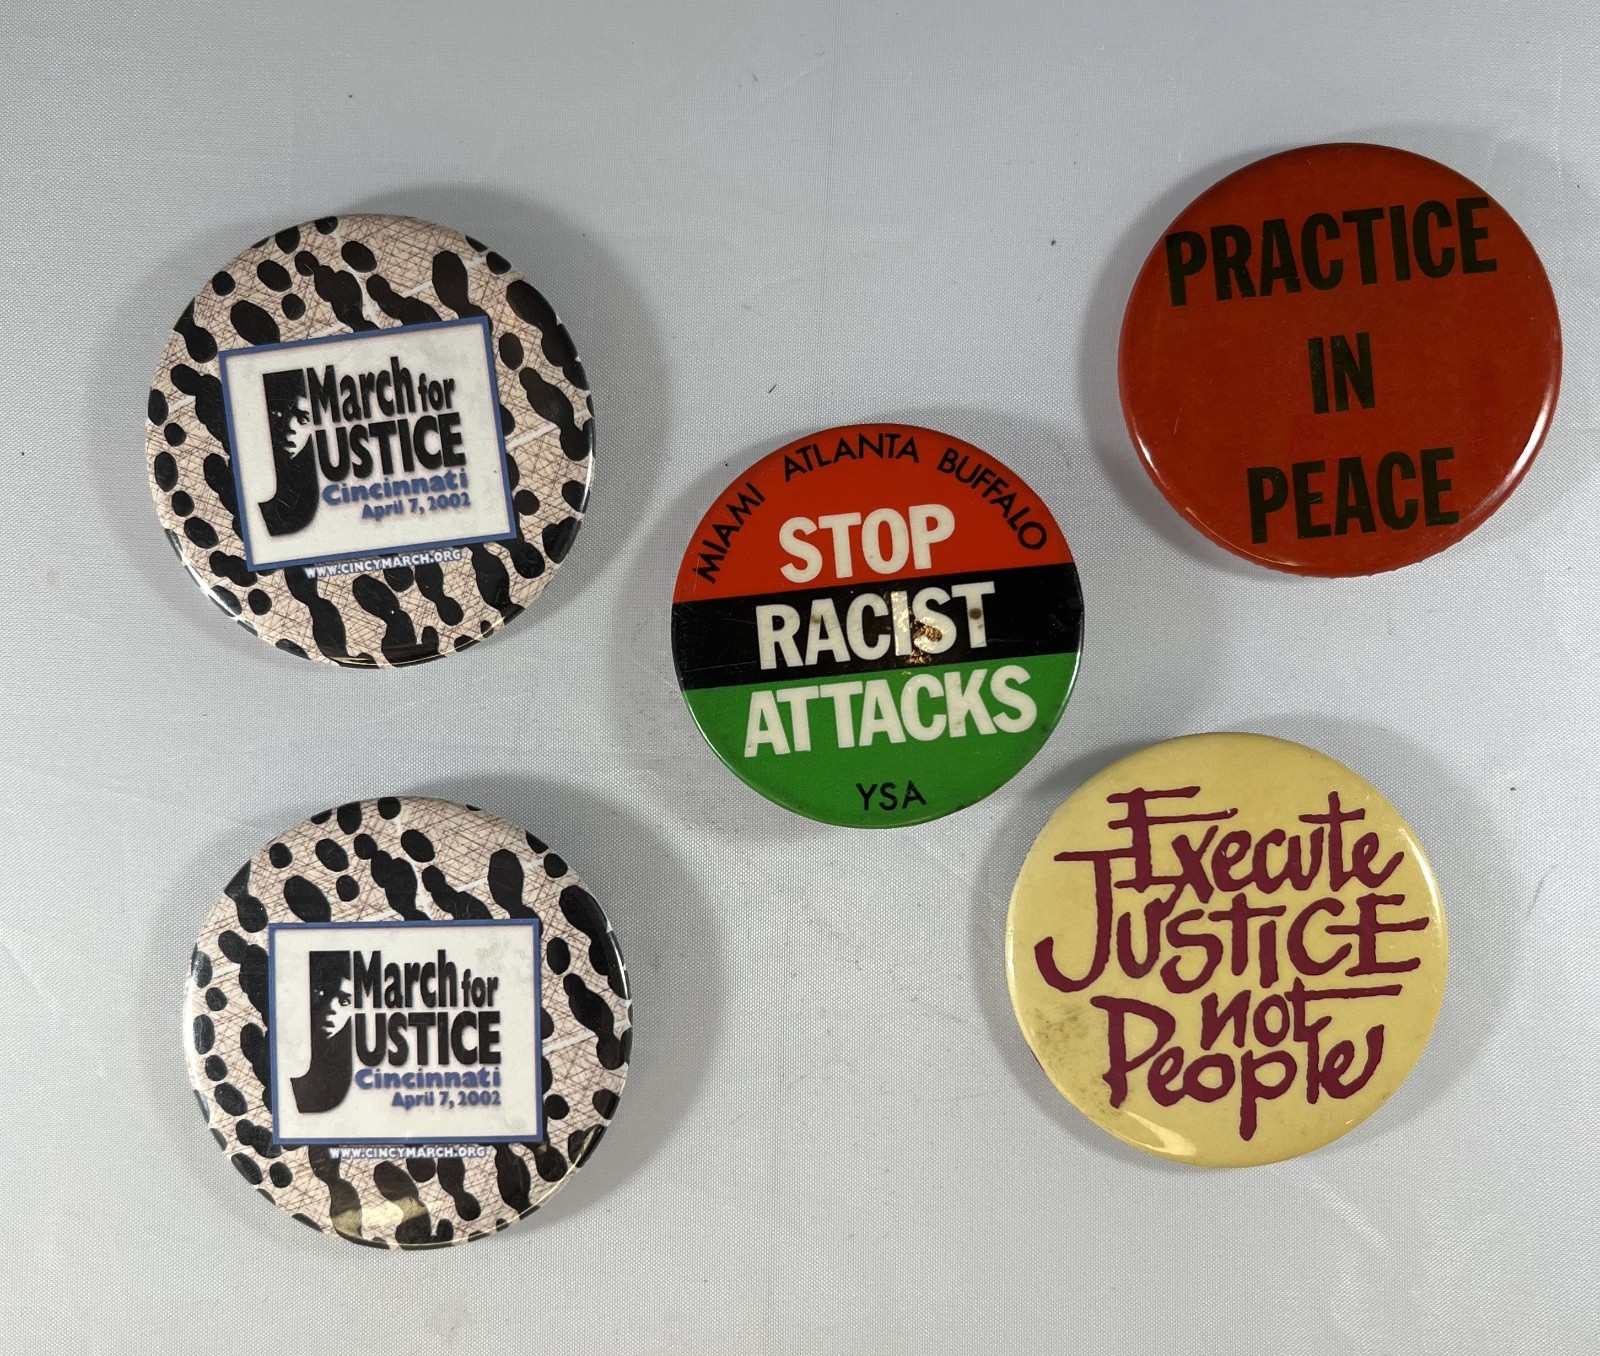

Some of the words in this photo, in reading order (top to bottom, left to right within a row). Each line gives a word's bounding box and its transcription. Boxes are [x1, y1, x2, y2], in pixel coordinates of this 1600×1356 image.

[1165, 197, 1497, 307] PRACTICE
[307, 356, 416, 425] March
[418, 373, 454, 412] for
[1307, 332, 1375, 414] IN
[322, 468, 468, 505] Cincinnati
[361, 499, 403, 521] April
[408, 499, 425, 515] 7,
[428, 492, 470, 511] 2002
[692, 482, 765, 583] MIAMI
[783, 433, 919, 482] ATLANTA
[937, 448, 1047, 551] BUFFALO
[1247, 447, 1459, 544] PEACE
[303, 549, 461, 578] WWW.CINCYMARCH.ORG
[778, 504, 955, 583] STOP
[755, 581, 995, 670] RACIST
[744, 665, 1037, 758] ATTACKS
[856, 780, 927, 812] YSA
[1106, 786, 1405, 903] Execute
[353, 949, 457, 1009] March
[461, 969, 499, 1008] for
[1200, 977, 1402, 1050] not
[355, 1066, 502, 1089] Cincinnati
[391, 1092, 434, 1110] April
[439, 1092, 455, 1109] 7,
[457, 1091, 502, 1106] 2002
[1090, 995, 1384, 1141] People
[328, 1146, 485, 1159] WWW.CINCYMARCH.ORG
